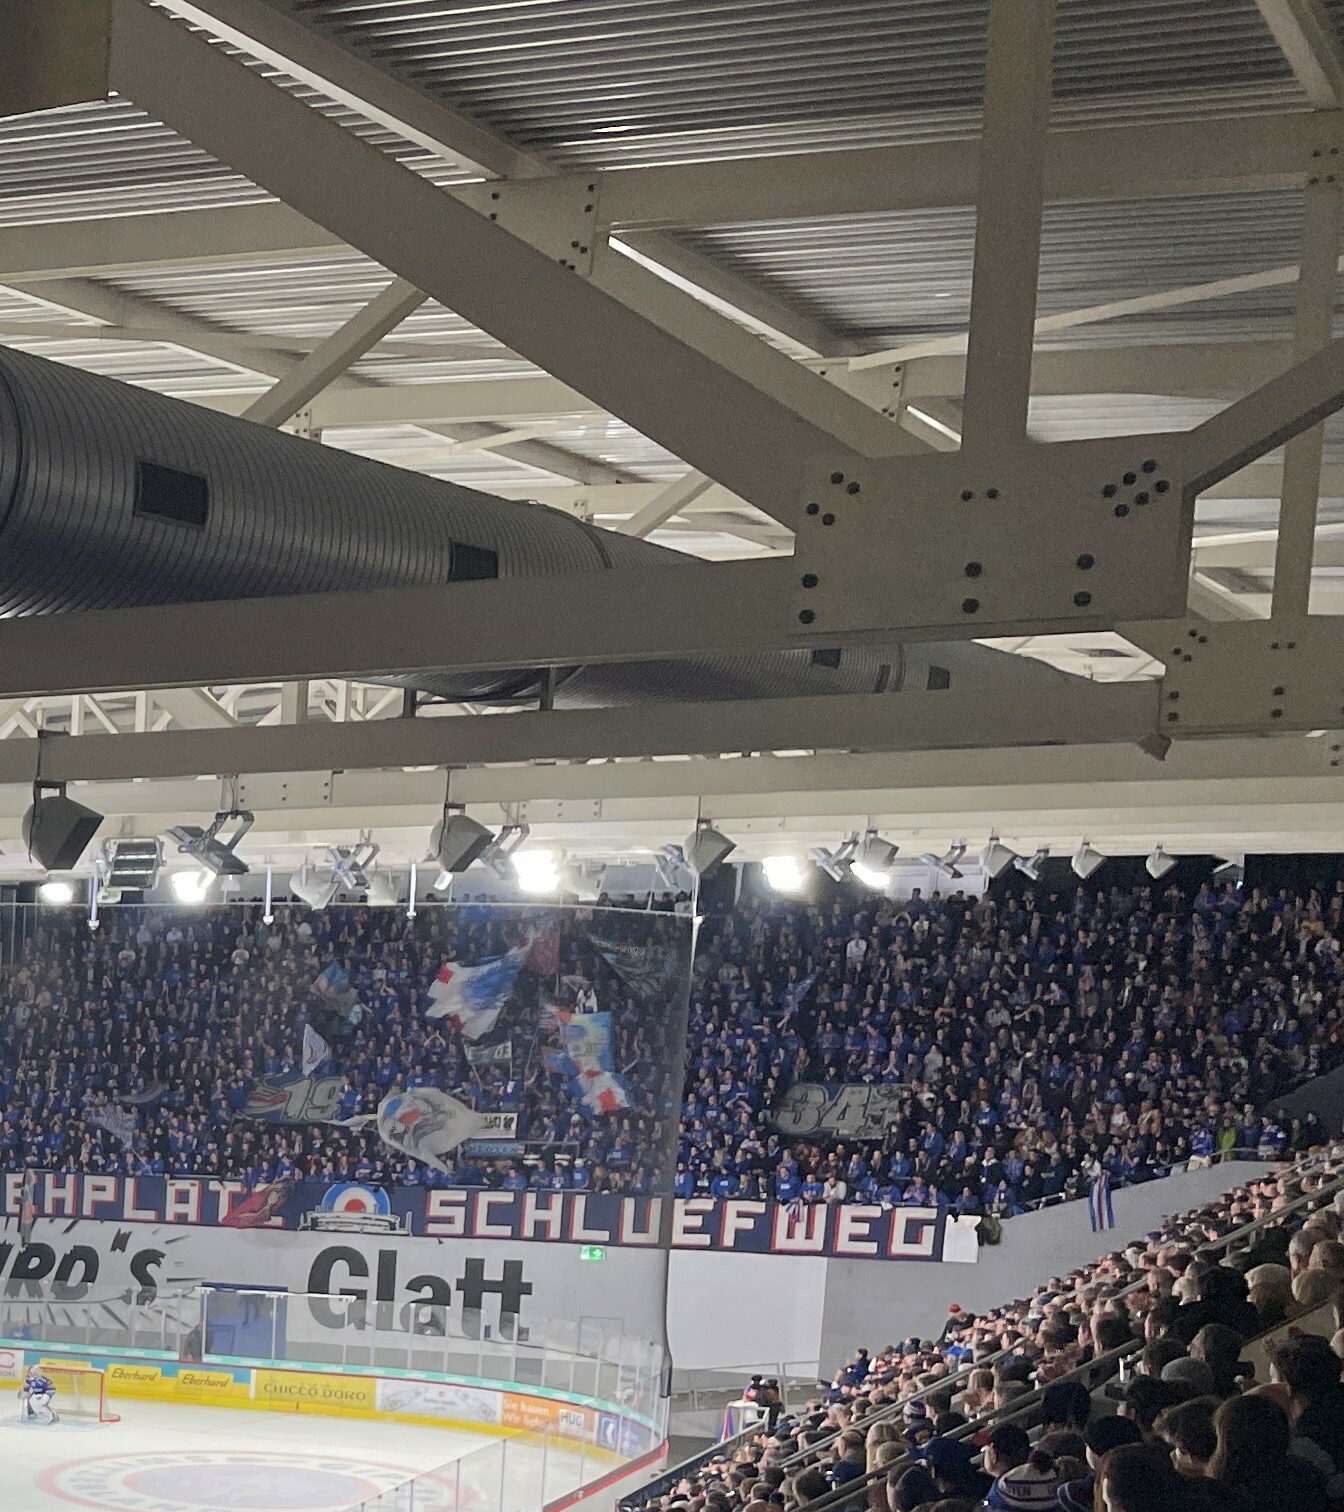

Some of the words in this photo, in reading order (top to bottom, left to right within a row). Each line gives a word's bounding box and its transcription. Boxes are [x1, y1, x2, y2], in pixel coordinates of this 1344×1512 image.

[425, 1190, 938, 1256] SCHLUEFWEG
[308, 1245, 532, 1341] Glatt
[112, 1368, 155, 1382] Eberhard
[182, 1374, 229, 1388] Eberhard
[264, 1383, 318, 1397] CHICCO
[323, 1388, 366, 1401] D'ORO
[503, 1399, 518, 1410] Sie
[503, 1413, 519, 1424] Wir
[561, 1411, 583, 1426] HUG
